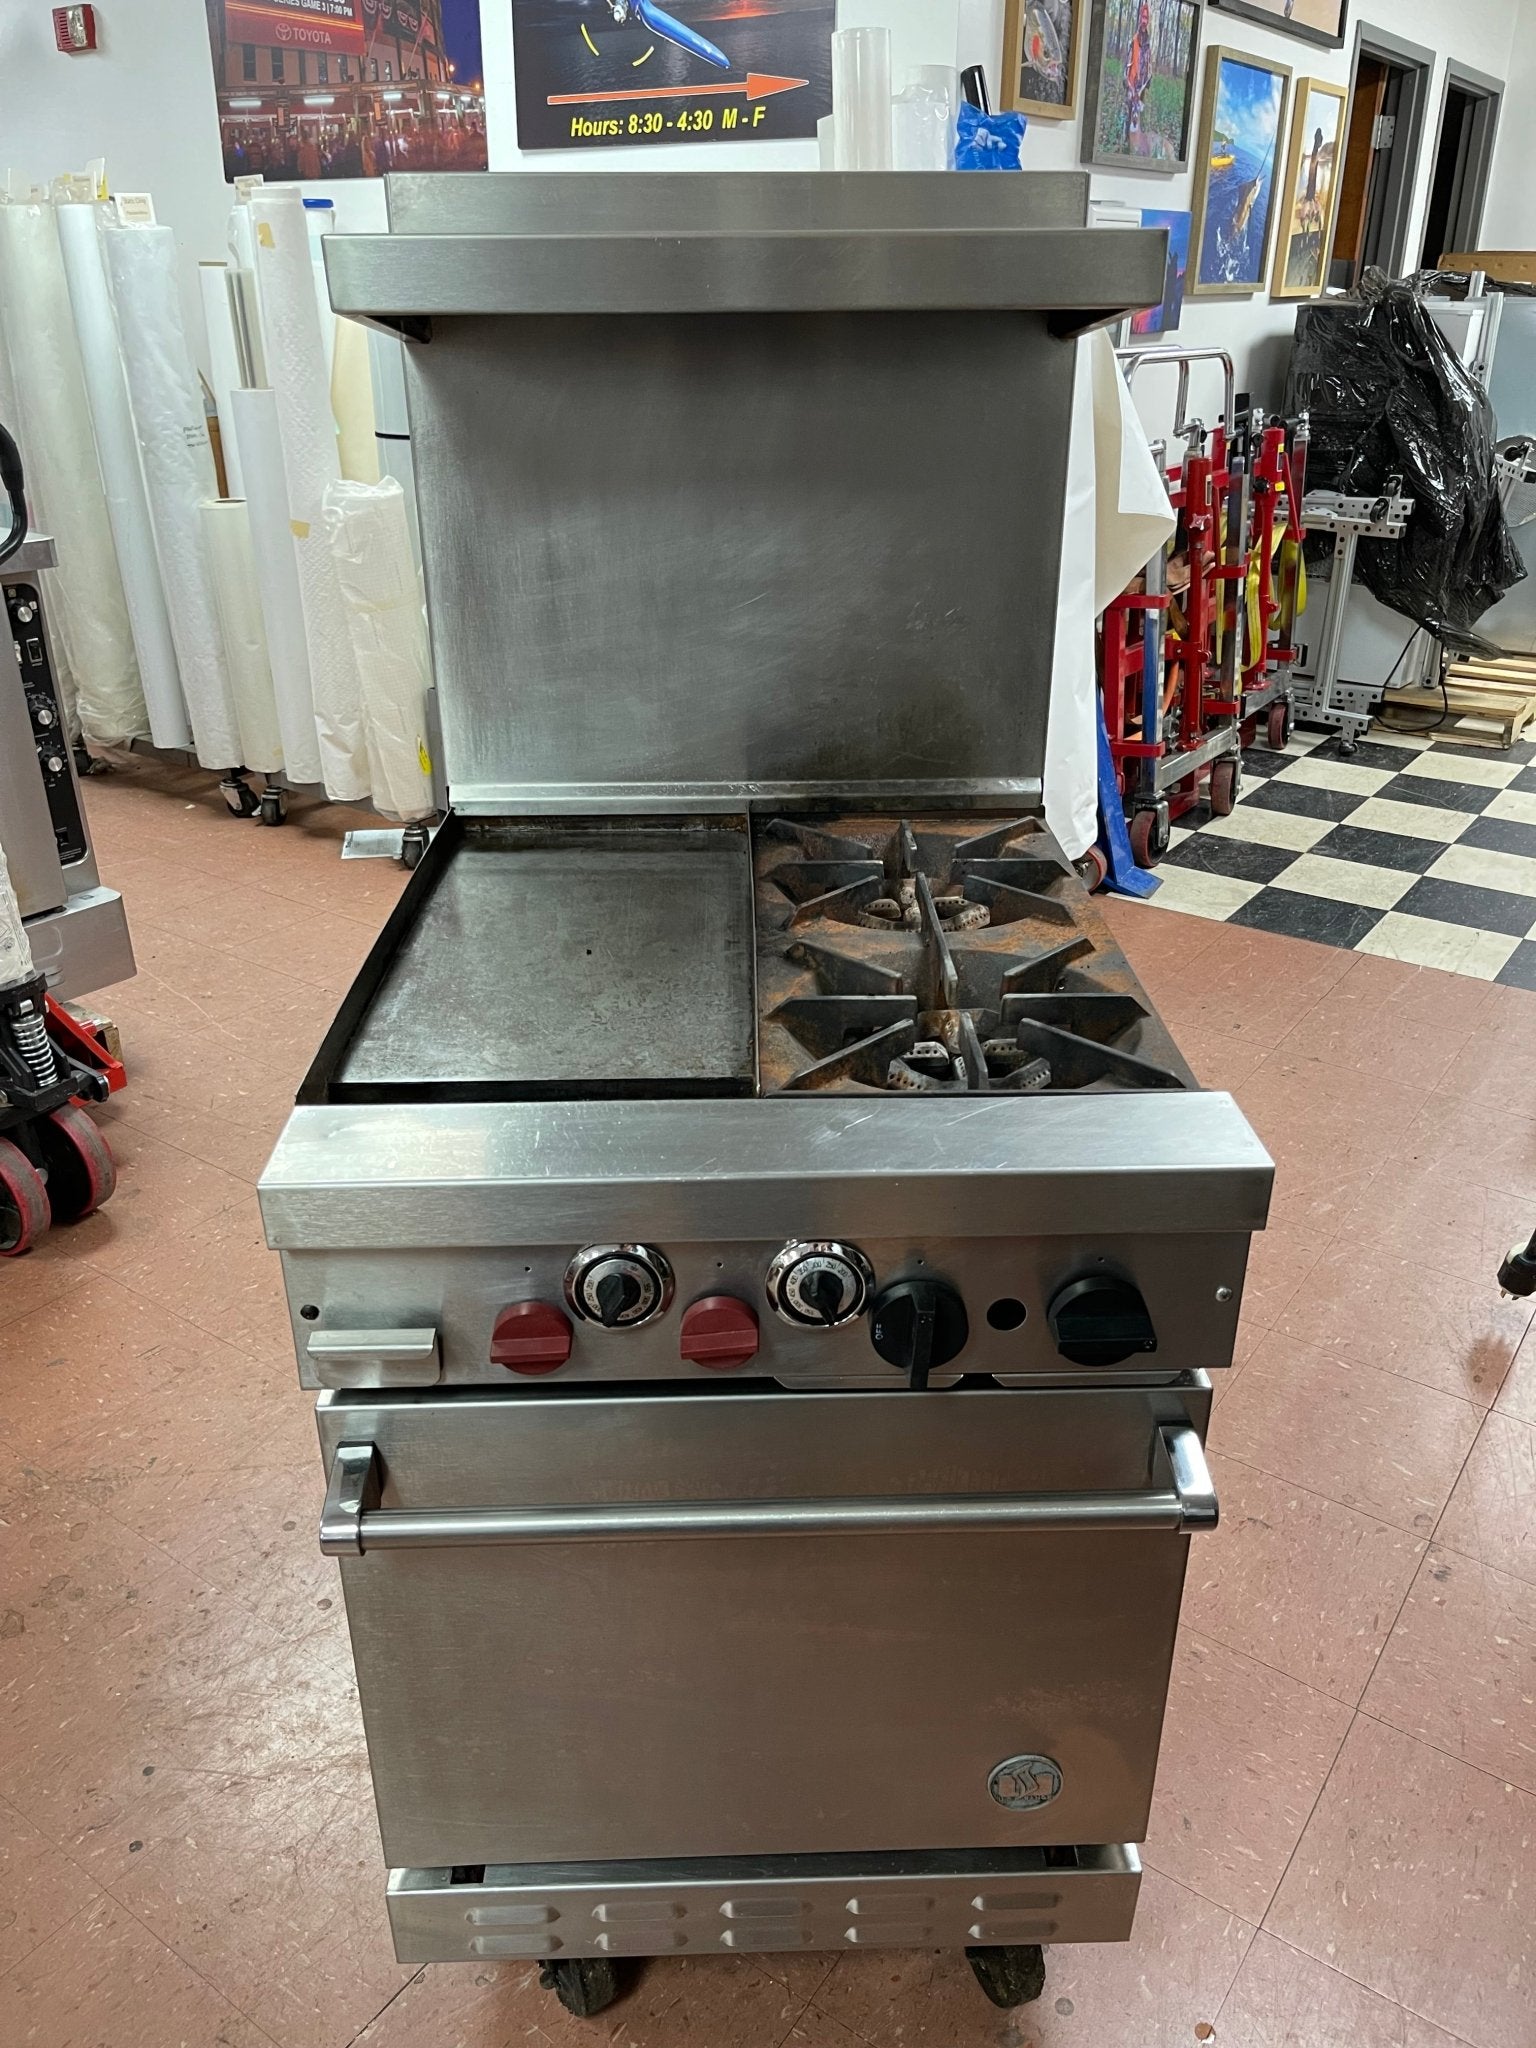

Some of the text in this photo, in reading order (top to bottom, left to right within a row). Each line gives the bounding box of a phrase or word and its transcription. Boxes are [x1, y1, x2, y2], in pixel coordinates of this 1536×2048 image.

[301, 0, 321, 10] GAME
[293, 28, 332, 45] TOYOTA
[570, 115, 624, 137] Hours:
[628, 113, 663, 134] 8:30
[677, 110, 713, 131] 4:30
[722, 107, 738, 129] M
[752, 106, 766, 127] F
[875, 1323, 884, 1340] OFF
